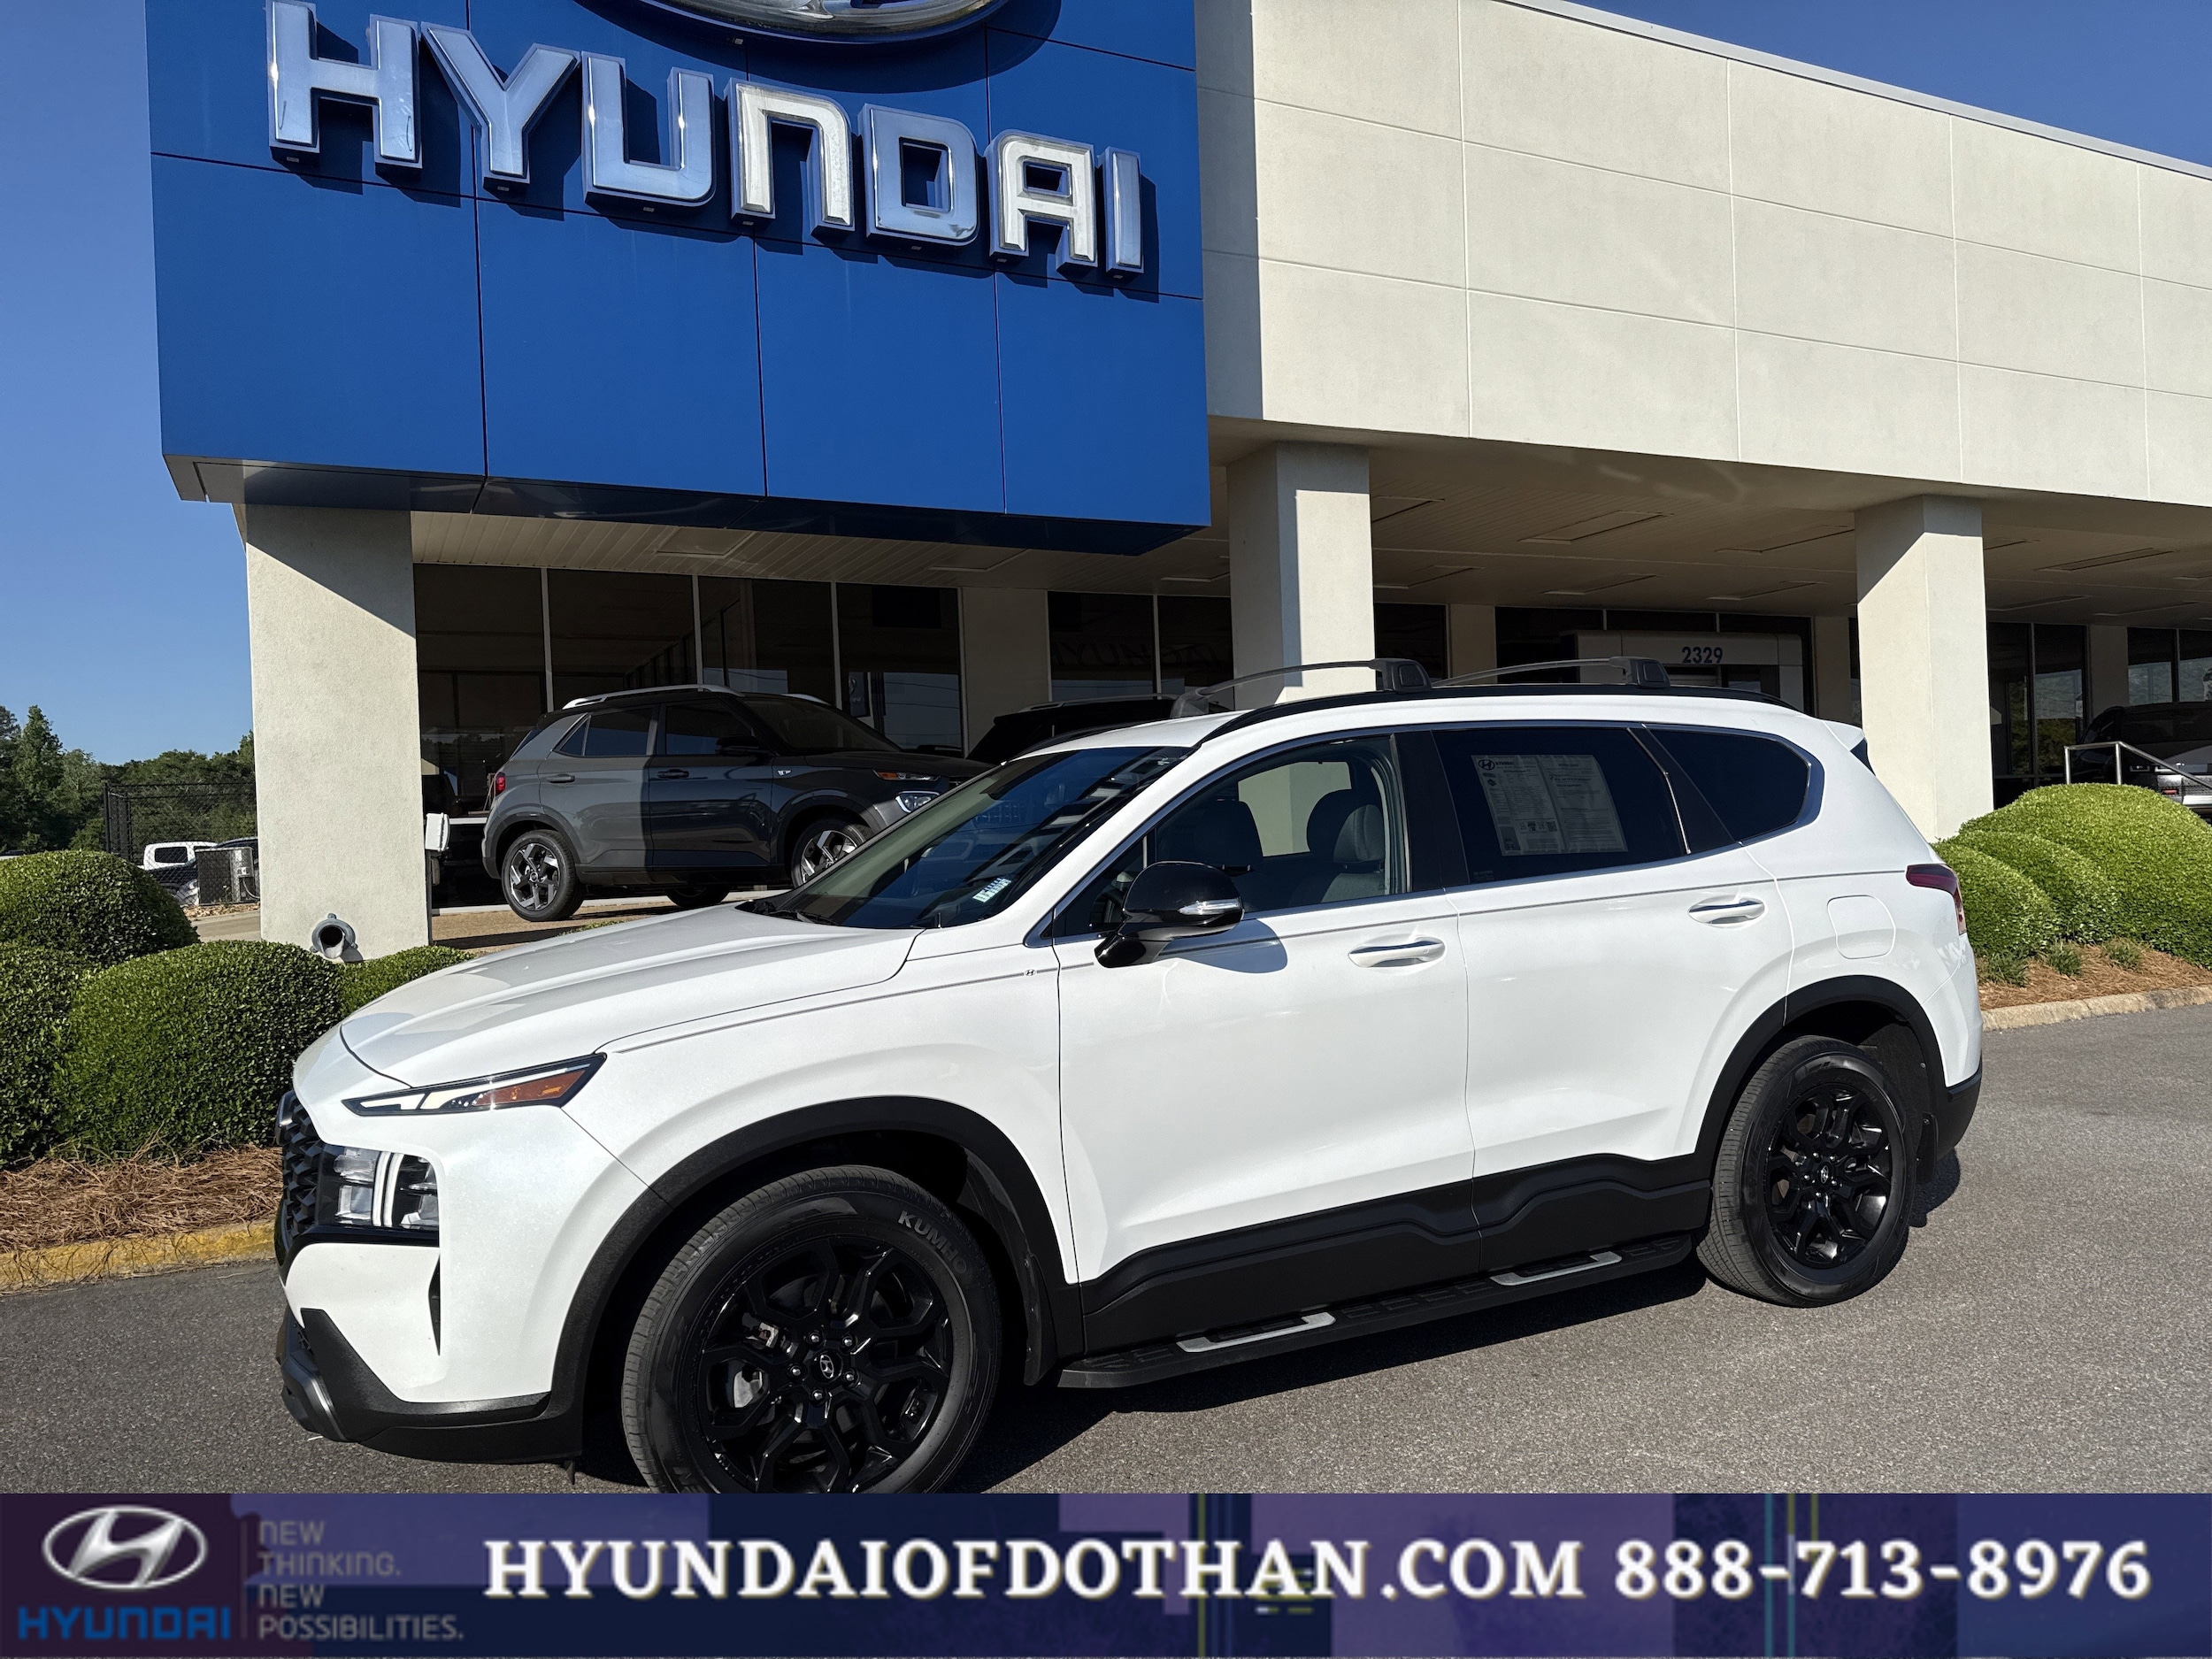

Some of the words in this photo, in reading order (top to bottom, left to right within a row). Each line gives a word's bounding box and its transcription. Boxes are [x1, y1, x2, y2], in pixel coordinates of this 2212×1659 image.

[266, 0, 1145, 279] HYUNDAI
[1681, 646, 1724, 664] 2329
[897, 1210, 967, 1274] KUMHO
